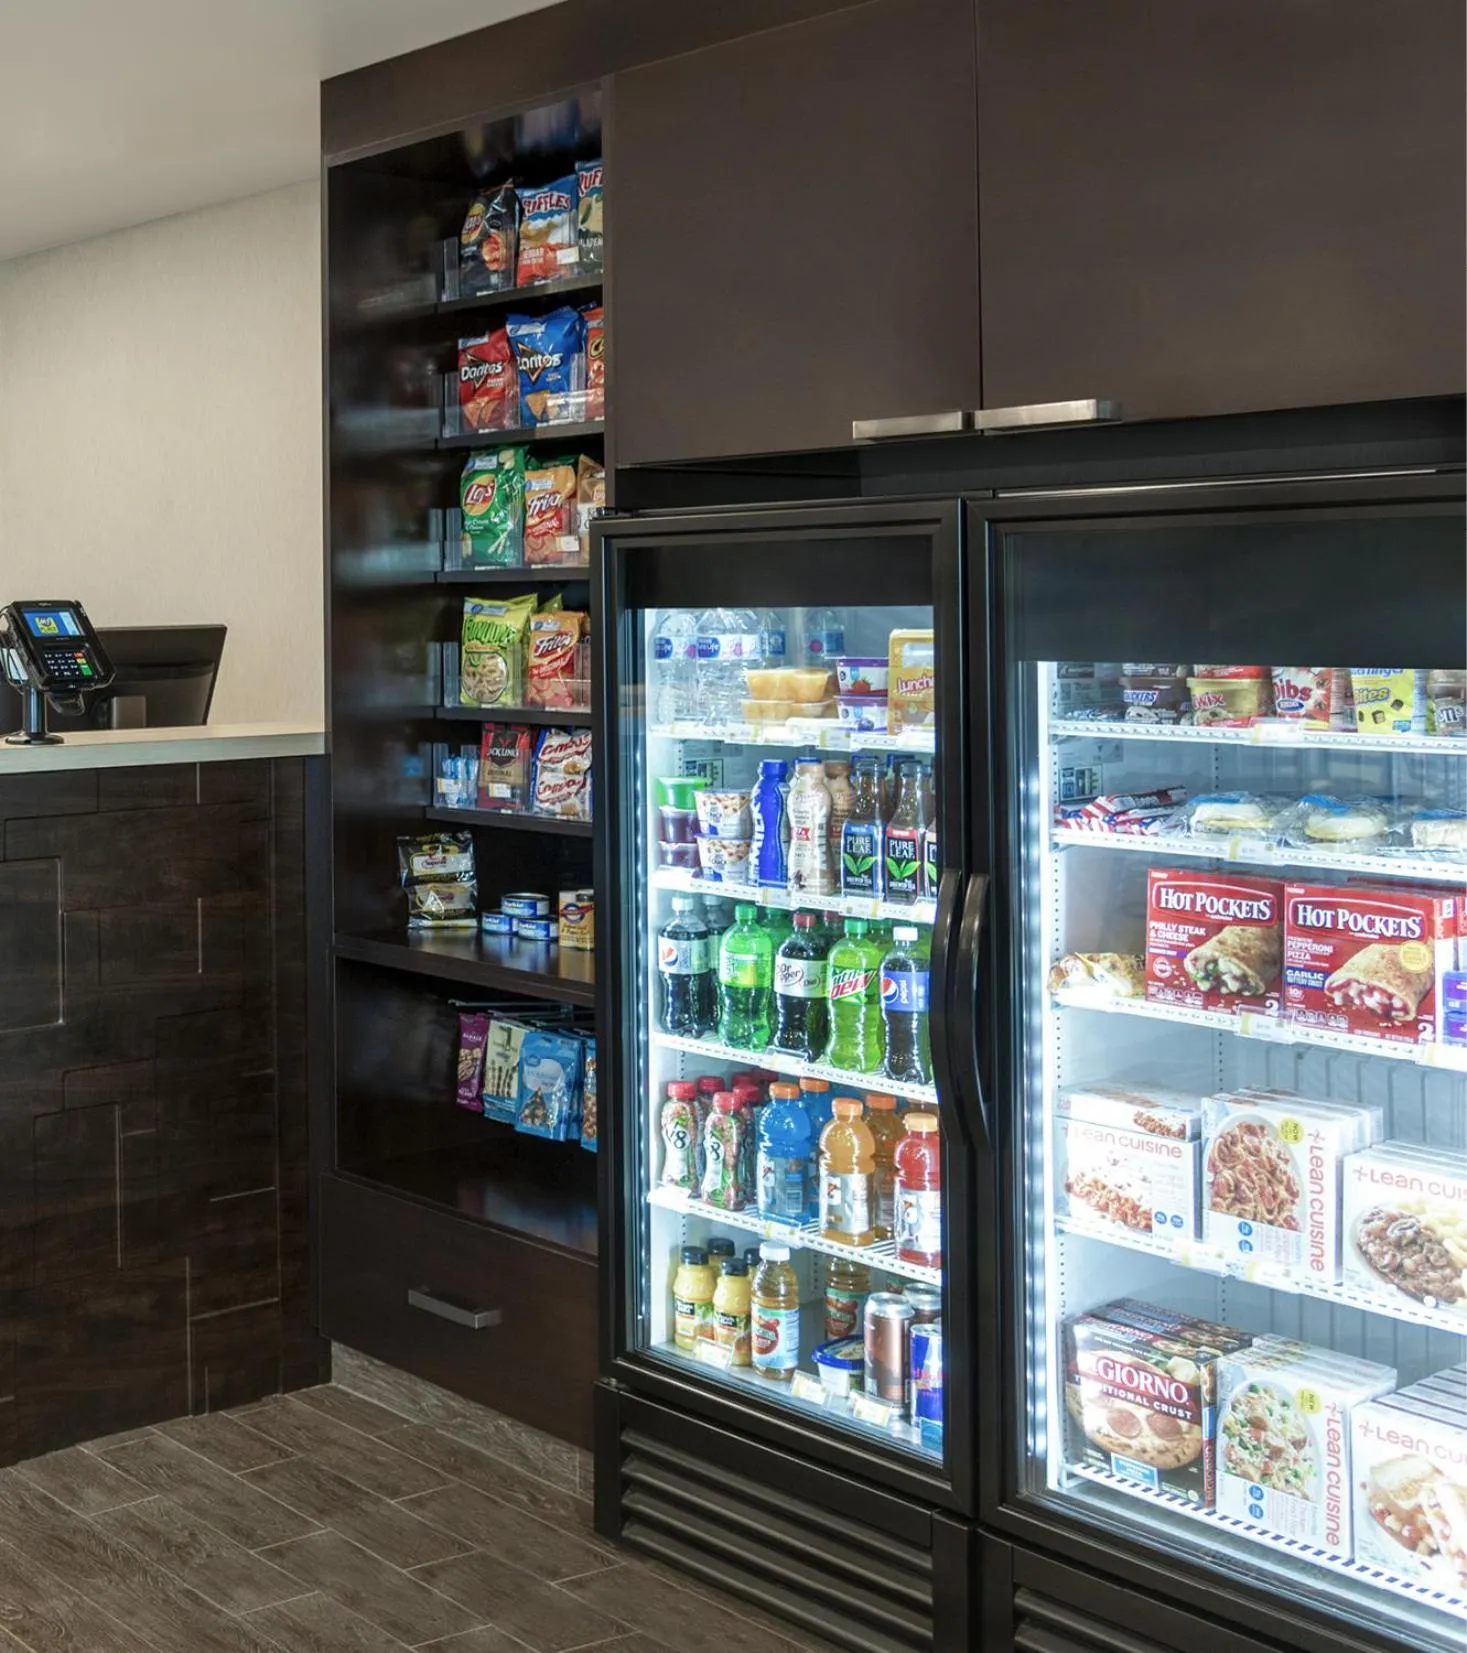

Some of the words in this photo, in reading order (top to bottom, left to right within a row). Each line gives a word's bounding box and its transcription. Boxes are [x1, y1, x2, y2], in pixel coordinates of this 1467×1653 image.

[461, 361, 504, 382] Doritos
[847, 836, 871, 846] PURE
[847, 844, 872, 855] LEAF
[890, 840, 914, 850] PURE
[890, 847, 915, 859] LEAF
[1159, 887, 1195, 911] HOT
[1195, 892, 1272, 921] POCKETS
[1149, 921, 1178, 933] PHILLY
[1178, 924, 1206, 936] STEAK
[1297, 903, 1335, 929] HOT
[1337, 908, 1422, 939] POCKETS
[1157, 930, 1189, 943] CHEESE
[1287, 950, 1311, 961] PIZZA
[1286, 969, 1324, 981] GARLIC
[1118, 1136, 1183, 1159] cuisine
[1308, 1144, 1326, 1194] Lean
[1369, 1167, 1424, 1193] Lean
[1308, 1196, 1326, 1272] cuisine
[1153, 1401, 1193, 1420] CRUST
[1326, 1413, 1342, 1469] Lean
[1376, 1425, 1430, 1454] Lean
[1325, 1470, 1342, 1547] cuisine
